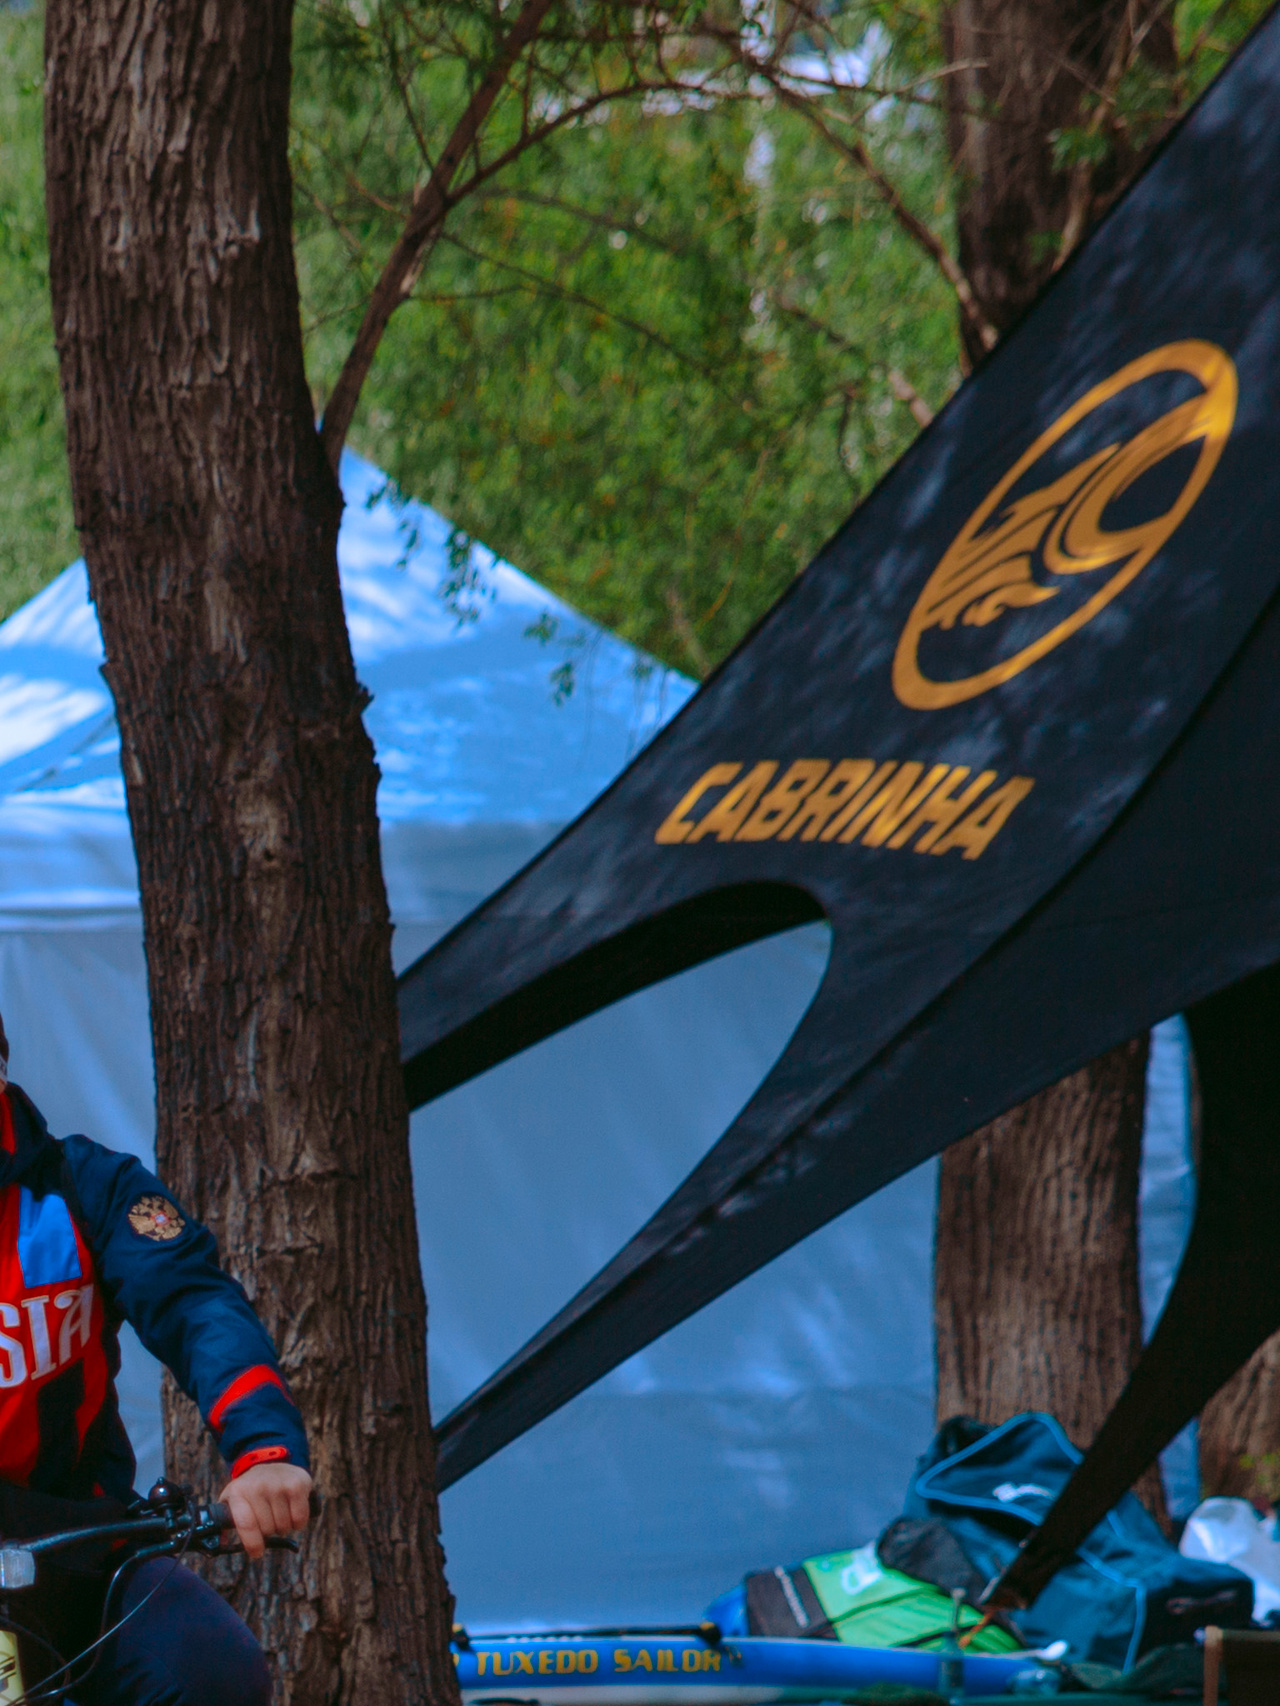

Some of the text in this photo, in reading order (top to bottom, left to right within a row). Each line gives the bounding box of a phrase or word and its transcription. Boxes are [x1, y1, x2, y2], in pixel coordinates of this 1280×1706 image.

[654, 757, 1036, 861] CABRINHA
[475, 1647, 721, 1676] TUXEDO SAILOR
